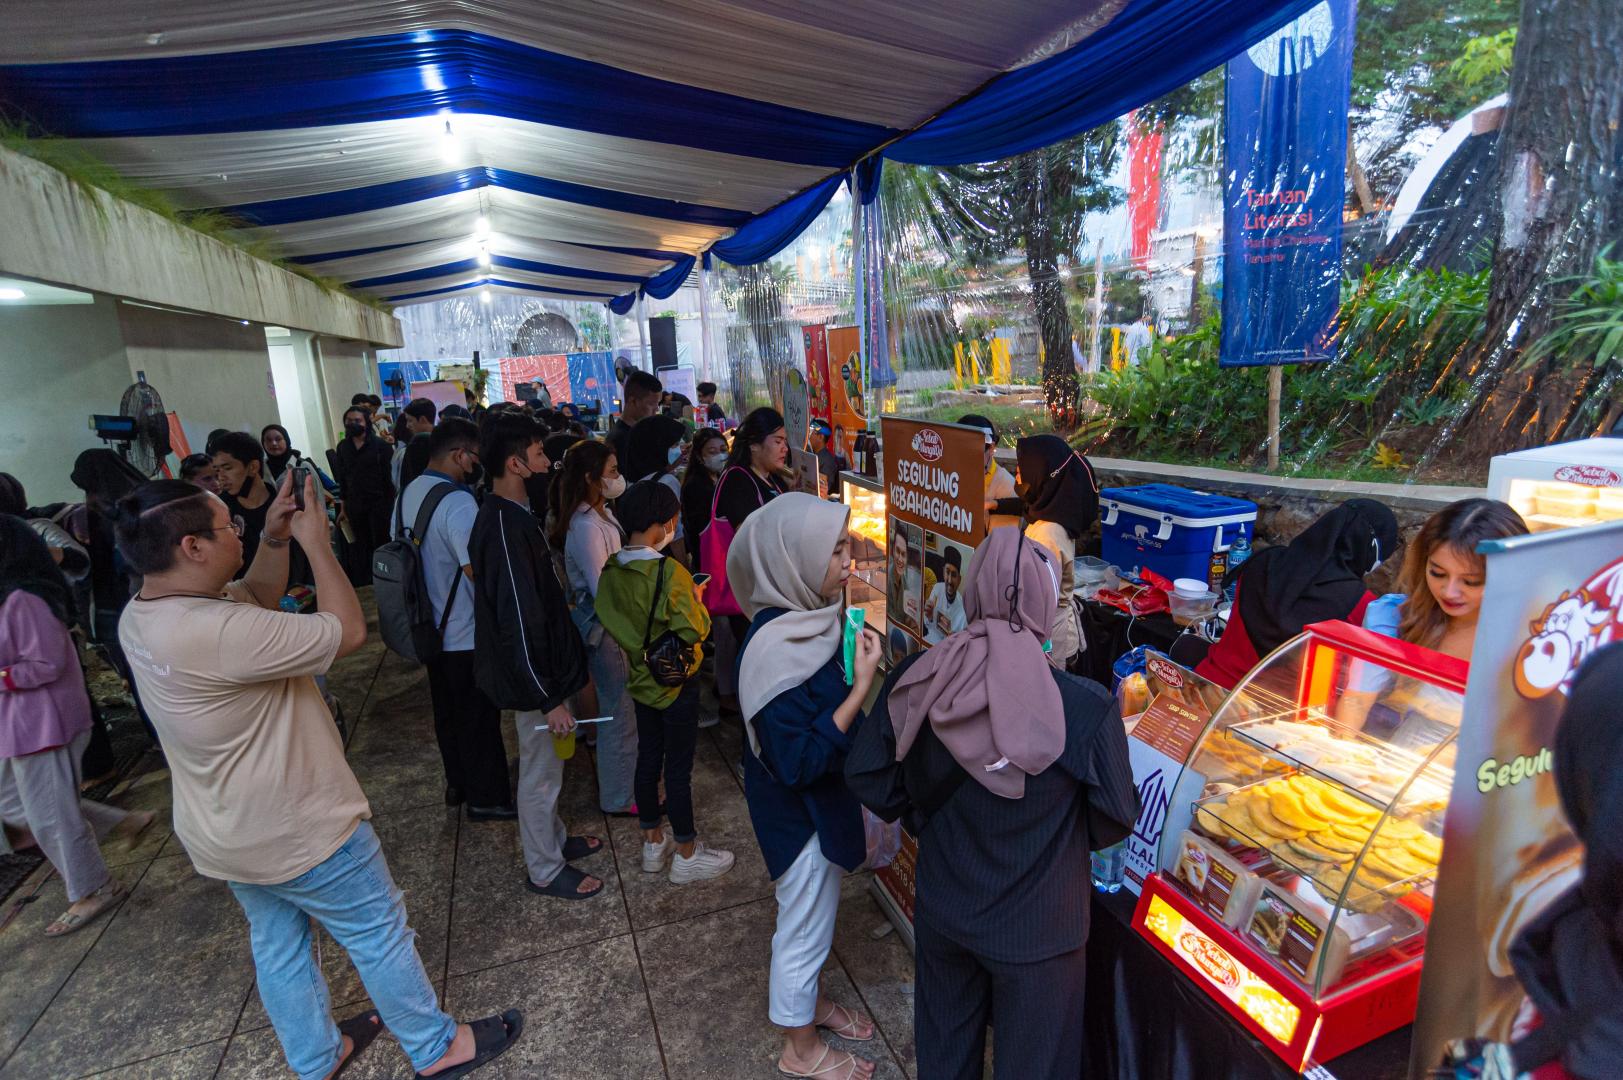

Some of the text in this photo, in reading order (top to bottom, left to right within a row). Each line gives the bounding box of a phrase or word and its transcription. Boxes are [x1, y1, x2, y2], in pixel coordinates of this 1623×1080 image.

[1247, 189, 1306, 207] Taman
[1244, 208, 1313, 230] Literasi
[898, 459, 959, 499] SEGULUNG
[890, 482, 973, 533] KEBAHAGIAAN
[1125, 837, 1155, 867] LAL
[1126, 852, 1153, 873] NESIA
